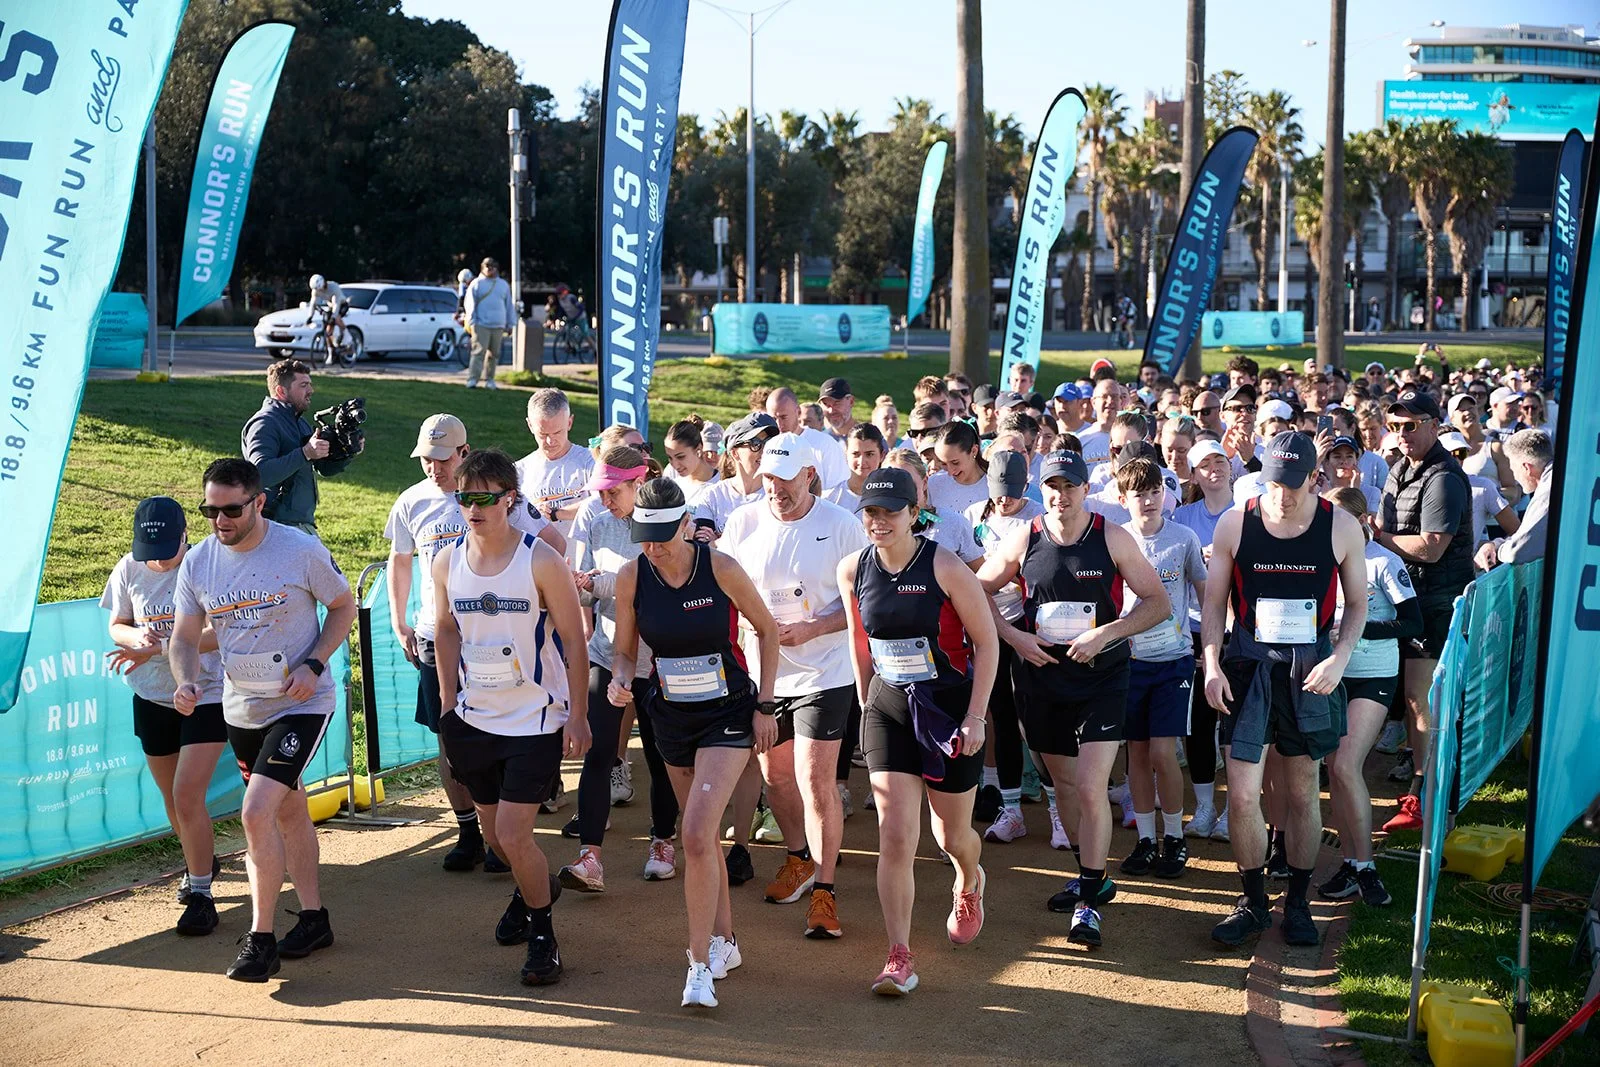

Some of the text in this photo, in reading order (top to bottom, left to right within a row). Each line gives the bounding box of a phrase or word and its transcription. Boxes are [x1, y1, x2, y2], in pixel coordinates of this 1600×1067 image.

[87, 48, 123, 133] and
[615, 23, 651, 153] RUN
[649, 103, 667, 172] PARTY
[53, 138, 95, 219] RUN
[193, 78, 252, 284] CONNOR'S RUN
[1031, 143, 1060, 226] RUN
[648, 177, 661, 224] and
[1186, 170, 1221, 241] RUN
[1555, 173, 1572, 246] RUN
[1210, 212, 1221, 251] PARTY
[31, 233, 69, 311] FUN
[22, 333, 47, 369] KM
[765, 448, 790, 457] ORDS
[1271, 450, 1300, 460] ORDS
[865, 481, 894, 491] ORDS
[1075, 569, 1103, 577] ORDS
[1253, 562, 1317, 572] ORD MINNETT
[209, 588, 283, 611] CONNOR'S
[456, 600, 528, 611] BAKER MOTORS
[682, 597, 714, 609] ORDS
[897, 584, 927, 592] ORDS
[232, 608, 260, 620] RUN
[47, 697, 98, 733] RUN
[86, 743, 99, 754] KM
[45, 768, 70, 782] RUN
[95, 755, 128, 772] PARTY
